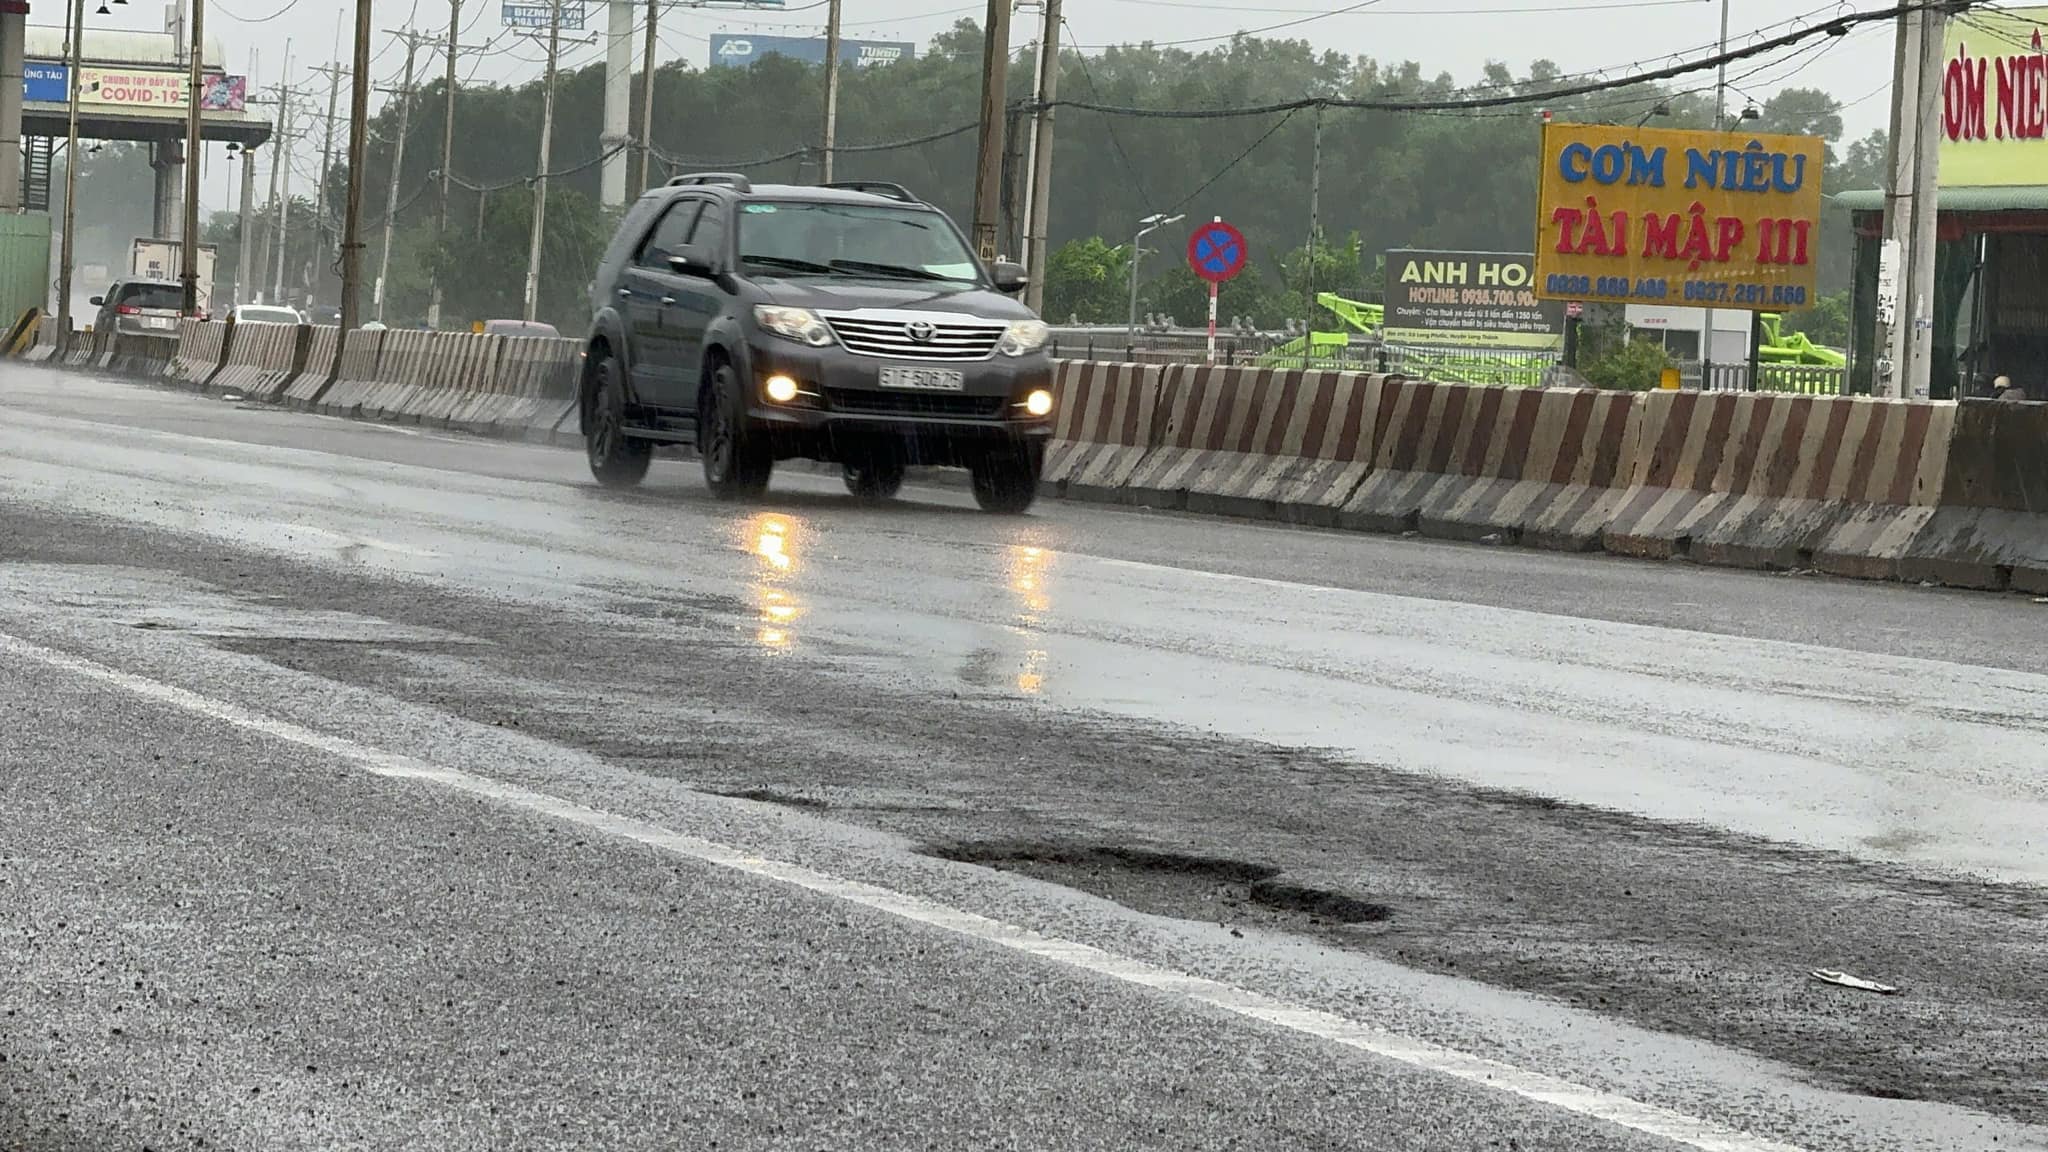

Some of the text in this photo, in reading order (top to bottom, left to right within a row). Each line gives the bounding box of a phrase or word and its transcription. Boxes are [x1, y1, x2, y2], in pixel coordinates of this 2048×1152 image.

[24, 68, 43, 79] ŨNG
[1940, 27, 2048, 141] ƠM NIÊ
[1559, 139, 1807, 193] CƠM NIÊU
[1552, 195, 1629, 256] TÀI
[1642, 201, 1745, 271] MẬP
[1400, 261, 1467, 284] ANH
[1409, 287, 1458, 304] HOTLINE:
